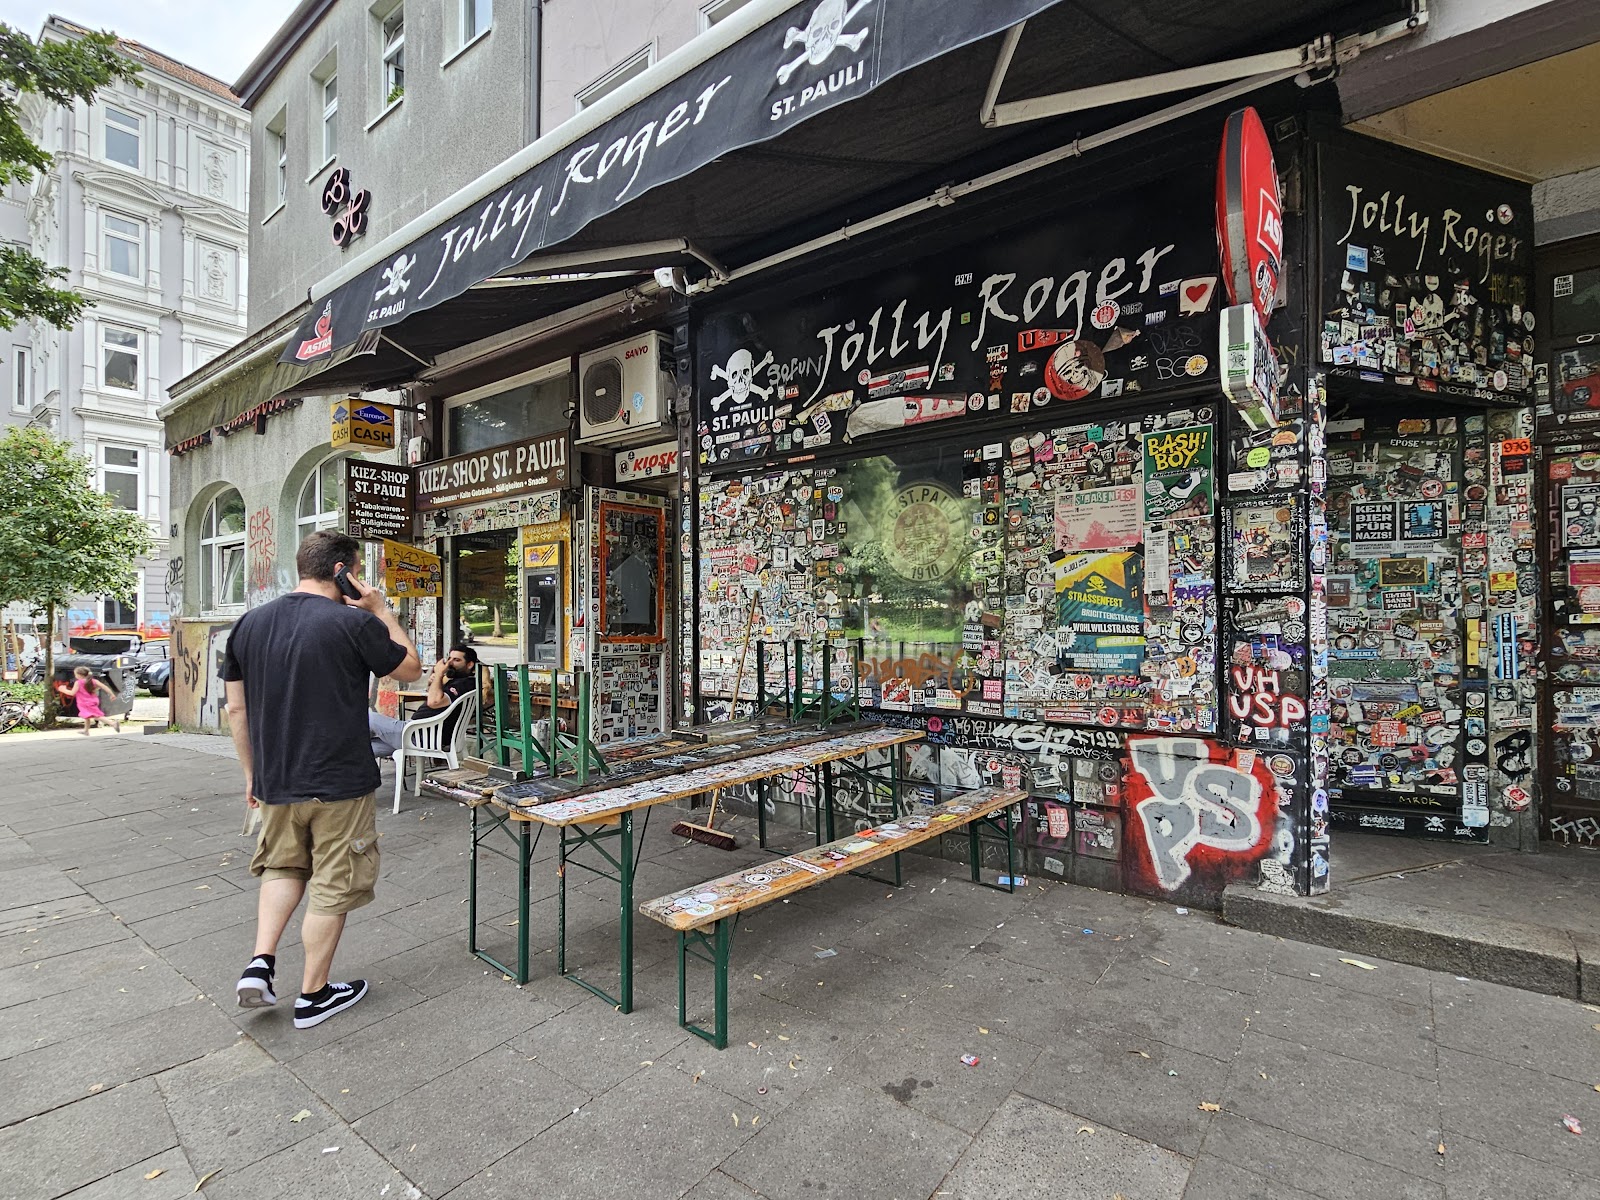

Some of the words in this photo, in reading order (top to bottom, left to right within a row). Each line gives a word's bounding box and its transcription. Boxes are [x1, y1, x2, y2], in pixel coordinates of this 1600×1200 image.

[770, 97, 796, 121] ST.
[800, 60, 864, 107] PAULI
[418, 184, 543, 300] Jolly
[551, 75, 732, 216] Roger
[1337, 185, 1430, 271] Jolly
[1440, 208, 1523, 285] Roger
[367, 309, 378, 322] ST.
[379, 299, 406, 319] PAULI
[803, 299, 952, 408] Jolly
[971, 245, 1175, 351] Roger
[625, 345, 648, 359] SANYO
[359, 410, 386, 421] Euronet
[712, 415, 731, 431] ST.
[732, 405, 773, 427] PAULI
[333, 428, 349, 441] CASH
[354, 427, 391, 441] CASH
[1147, 432, 1207, 456] BASH!
[419, 456, 489, 494] KIEZ-SHOP
[492, 450, 513, 479] ST.
[516, 437, 566, 474] PAULI
[633, 450, 678, 471] KIOSK
[1155, 448, 1198, 471] BOY
[350, 466, 409, 484] KIEZ-SHOP
[528, 475, 548, 486] Snacks
[354, 480, 372, 493] ST.
[373, 483, 406, 498] PAULI
[360, 501, 401, 512] Tabakwaren
[1355, 505, 1392, 513] KEIN
[355, 509, 373, 518] Kalte
[374, 512, 405, 521] Getränke
[1355, 513, 1392, 522] BIER
[360, 518, 401, 528] Süßigkeiten
[1355, 521, 1392, 531] FÜR
[368, 527, 393, 535] Snacks
[1355, 531, 1392, 540] NAZIS!
[911, 564, 940, 579] 1910
[1068, 591, 1123, 607] STRASSENFEST
[1081, 609, 1138, 623] BRIGITTENSTRASSE
[1073, 623, 1140, 634] WOHLWILLSTRASSE
[1230, 693, 1306, 726] USP
